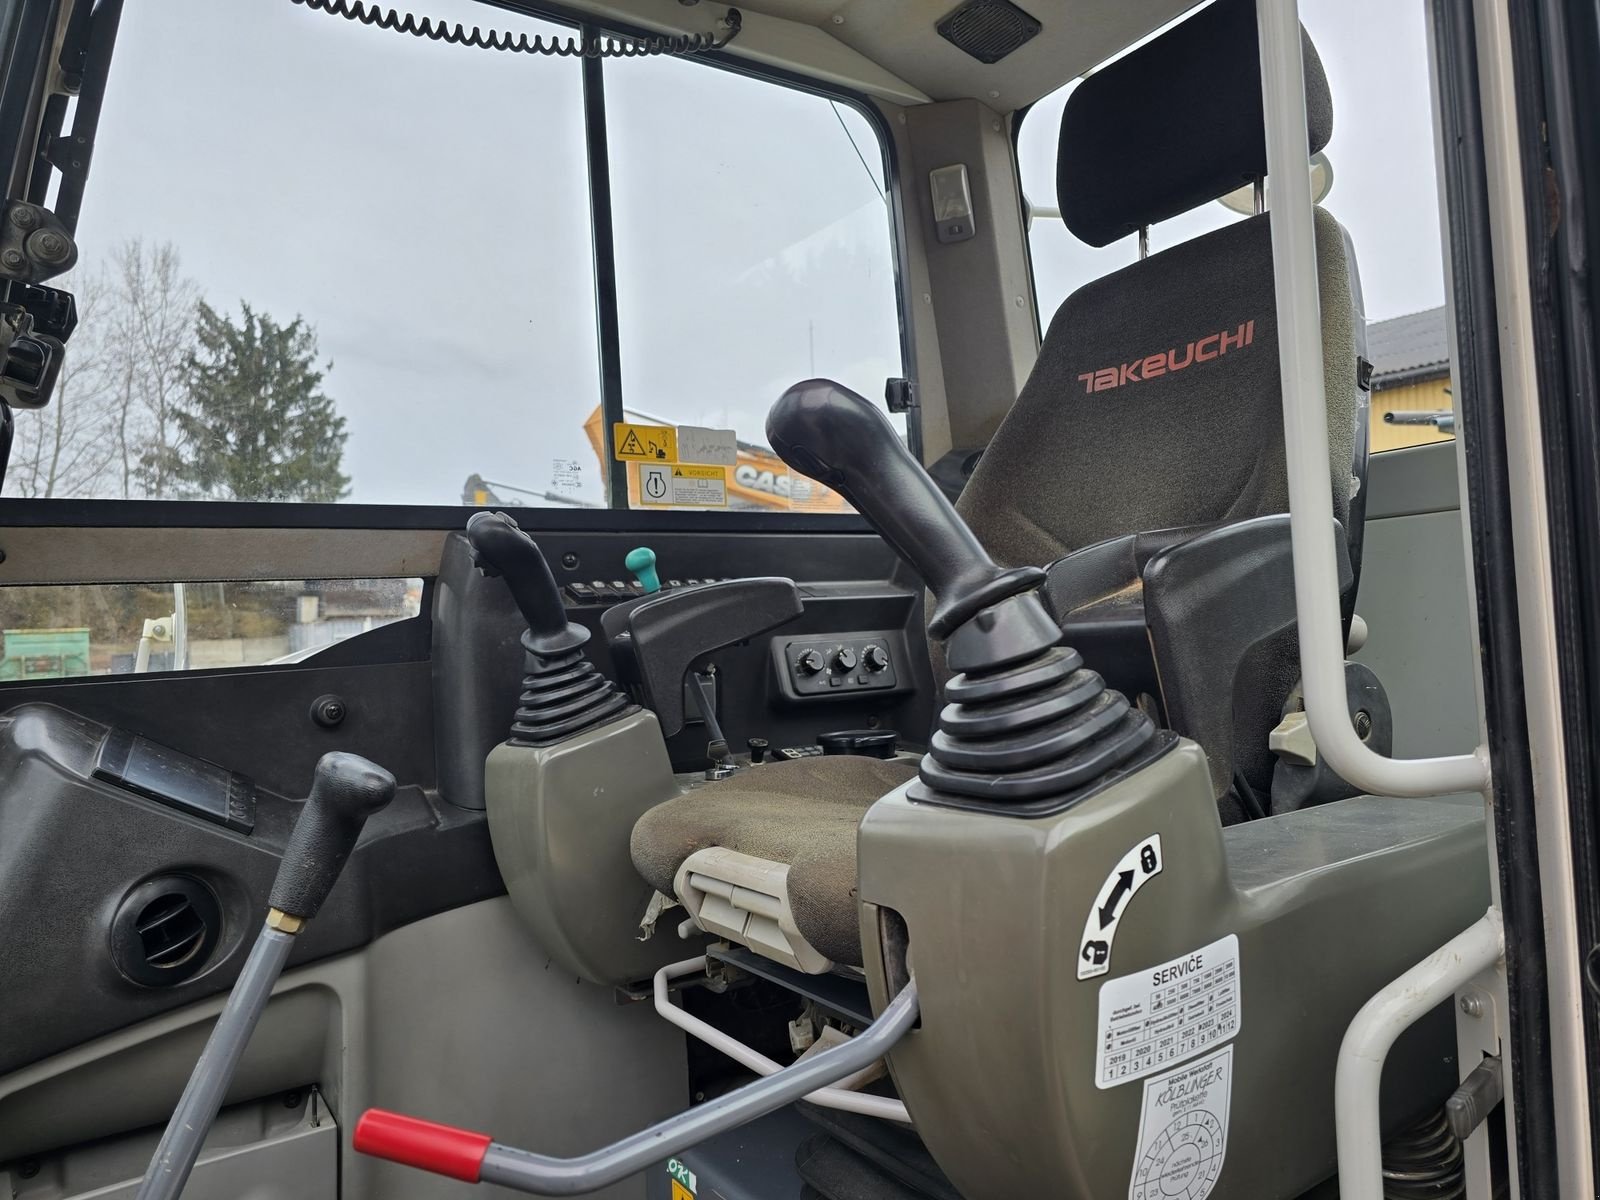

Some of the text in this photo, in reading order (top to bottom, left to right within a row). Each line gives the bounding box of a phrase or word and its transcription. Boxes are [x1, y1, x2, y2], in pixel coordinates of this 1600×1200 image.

[1078, 320, 1254, 393] TAKEUCHI
[1152, 955, 1203, 986] SERVICE
[1108, 1070, 1113, 1078] 1
[1121, 1066, 1127, 1075] 2
[1134, 1062, 1139, 1070] 3
[1146, 1057, 1152, 1065] 4
[1158, 1052, 1163, 1062] 5
[1169, 1048, 1174, 1057] 6
[1180, 1044, 1185, 1053] 7
[1190, 1039, 1196, 1048] 8
[1200, 1034, 1205, 1043] 9
[1208, 1029, 1216, 1039] 10
[1226, 1021, 1235, 1030] 12
[1110, 1010, 1232, 1064] 2019 2020 2021 2022 2023 2024
[1168, 1062, 1213, 1086] Mobile Werkstatt
